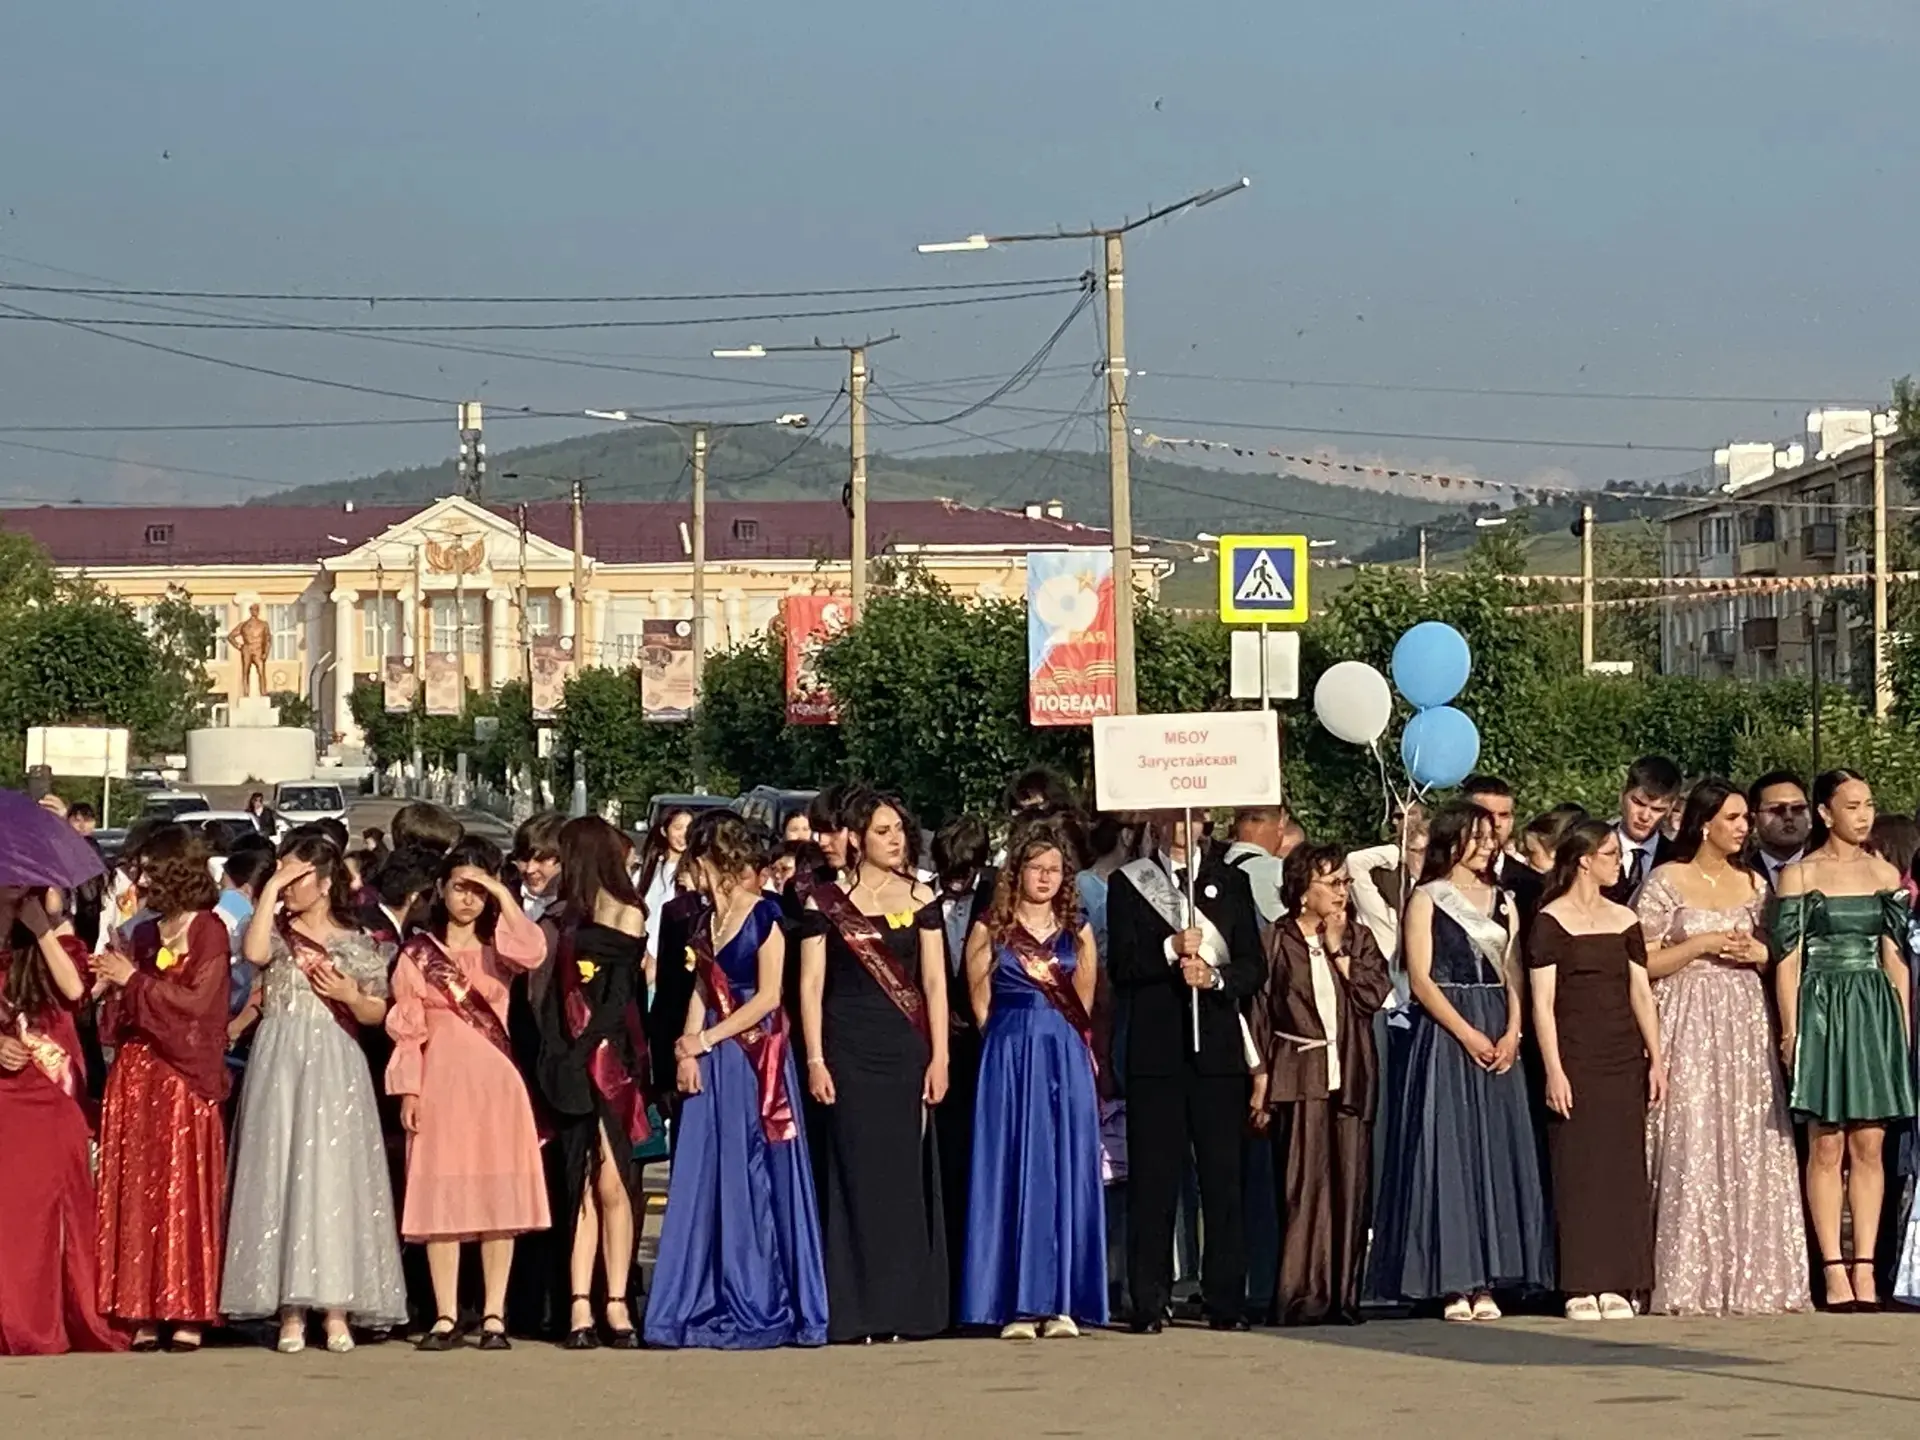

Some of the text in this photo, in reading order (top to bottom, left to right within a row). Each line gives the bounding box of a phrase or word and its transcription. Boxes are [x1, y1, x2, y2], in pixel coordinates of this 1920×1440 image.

[1034, 694, 1112, 714] ПОБЕДА!
[1164, 730, 1209, 745] МБОУ
[1137, 753, 1237, 770] Загустайская
[1170, 776, 1208, 790] СОШ
